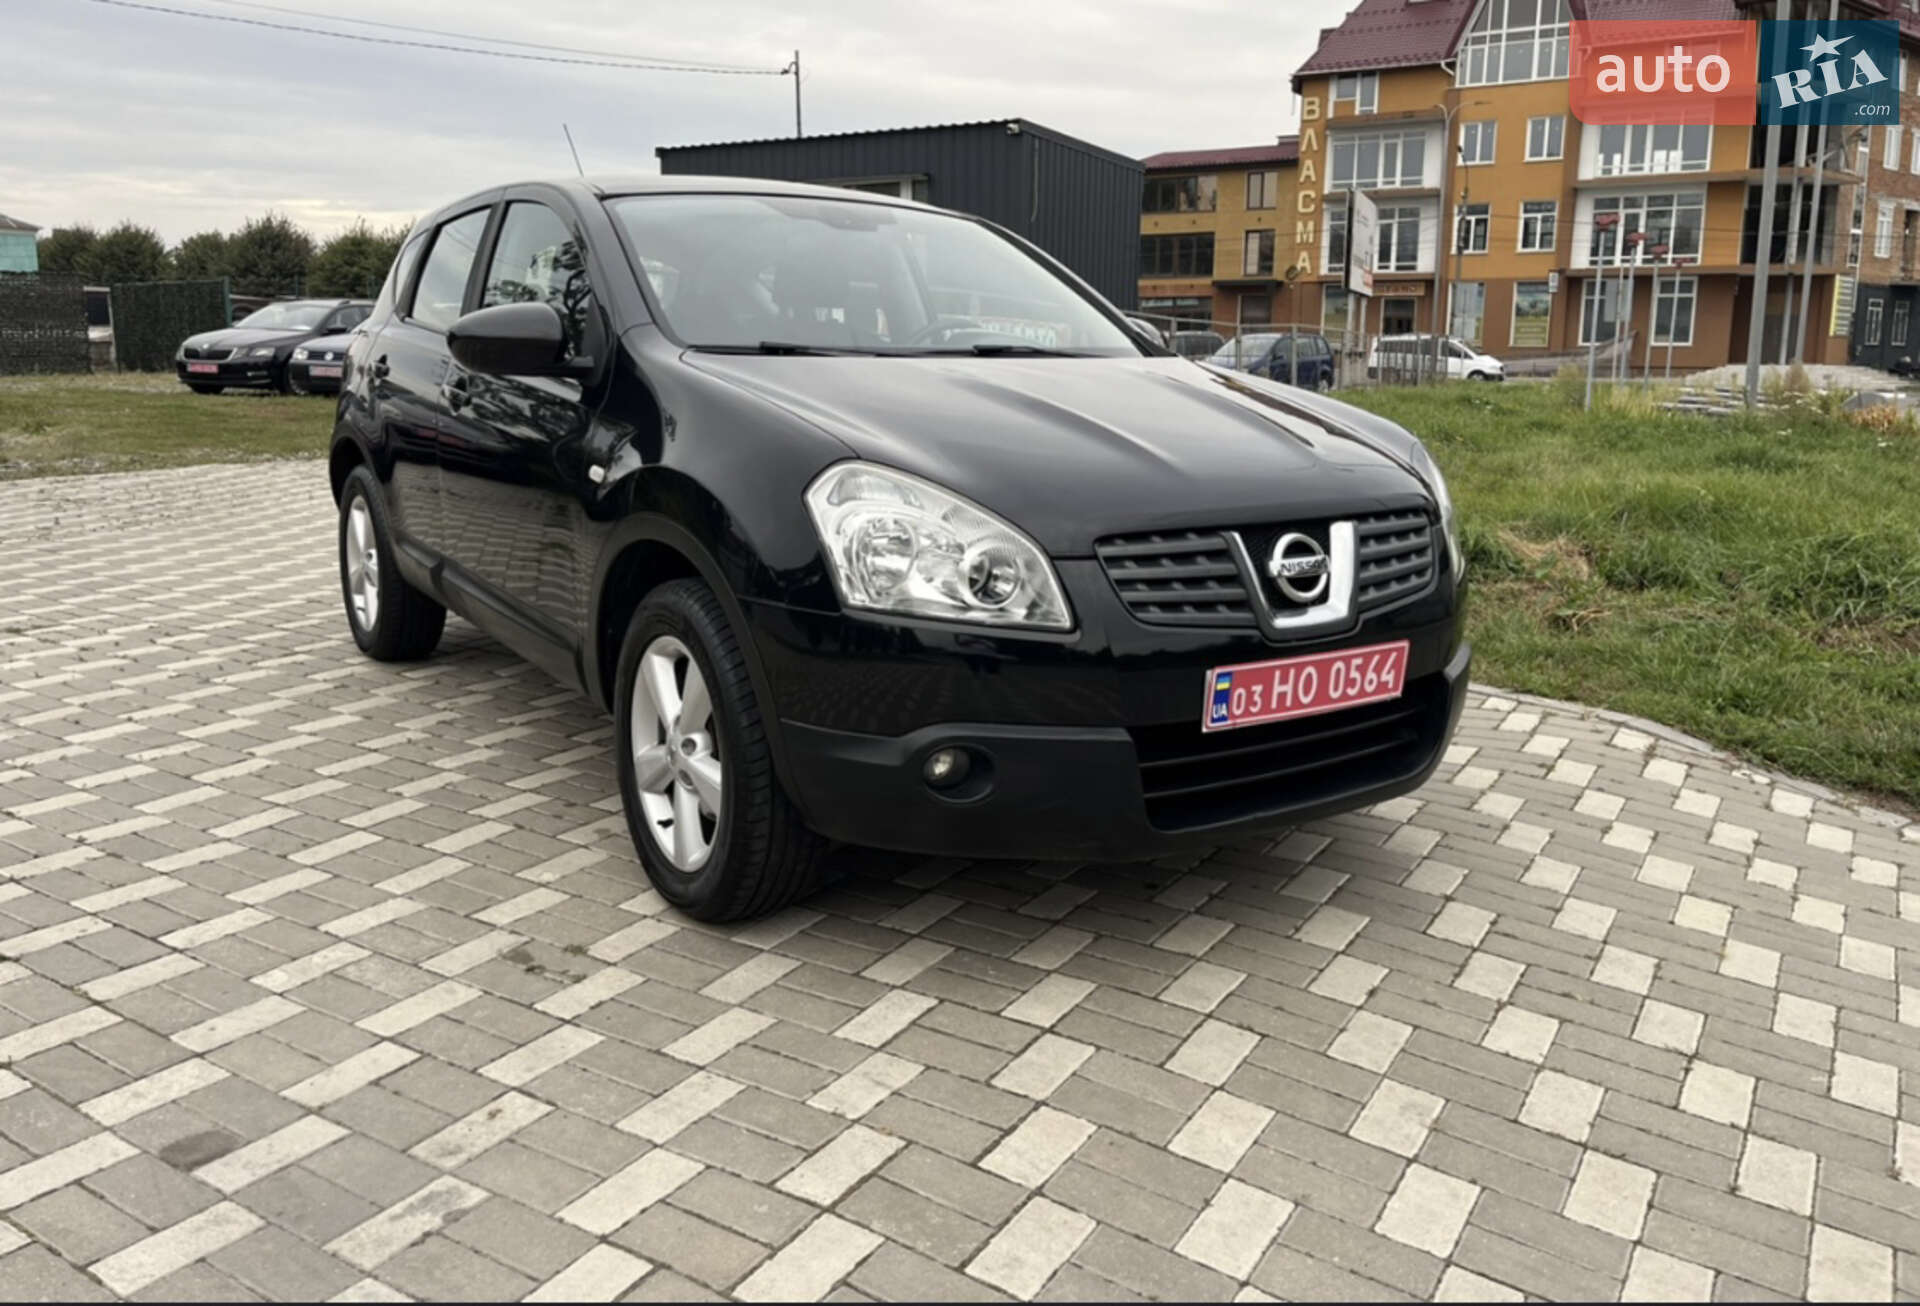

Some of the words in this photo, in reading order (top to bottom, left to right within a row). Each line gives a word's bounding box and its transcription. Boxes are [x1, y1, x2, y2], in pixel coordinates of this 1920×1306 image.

[1295, 97, 1321, 274] ВЛАСМА
[1212, 703, 1228, 719] UA
[1231, 684, 1264, 717] 03
[1271, 666, 1319, 710] HO
[1328, 652, 1398, 699] 0564
